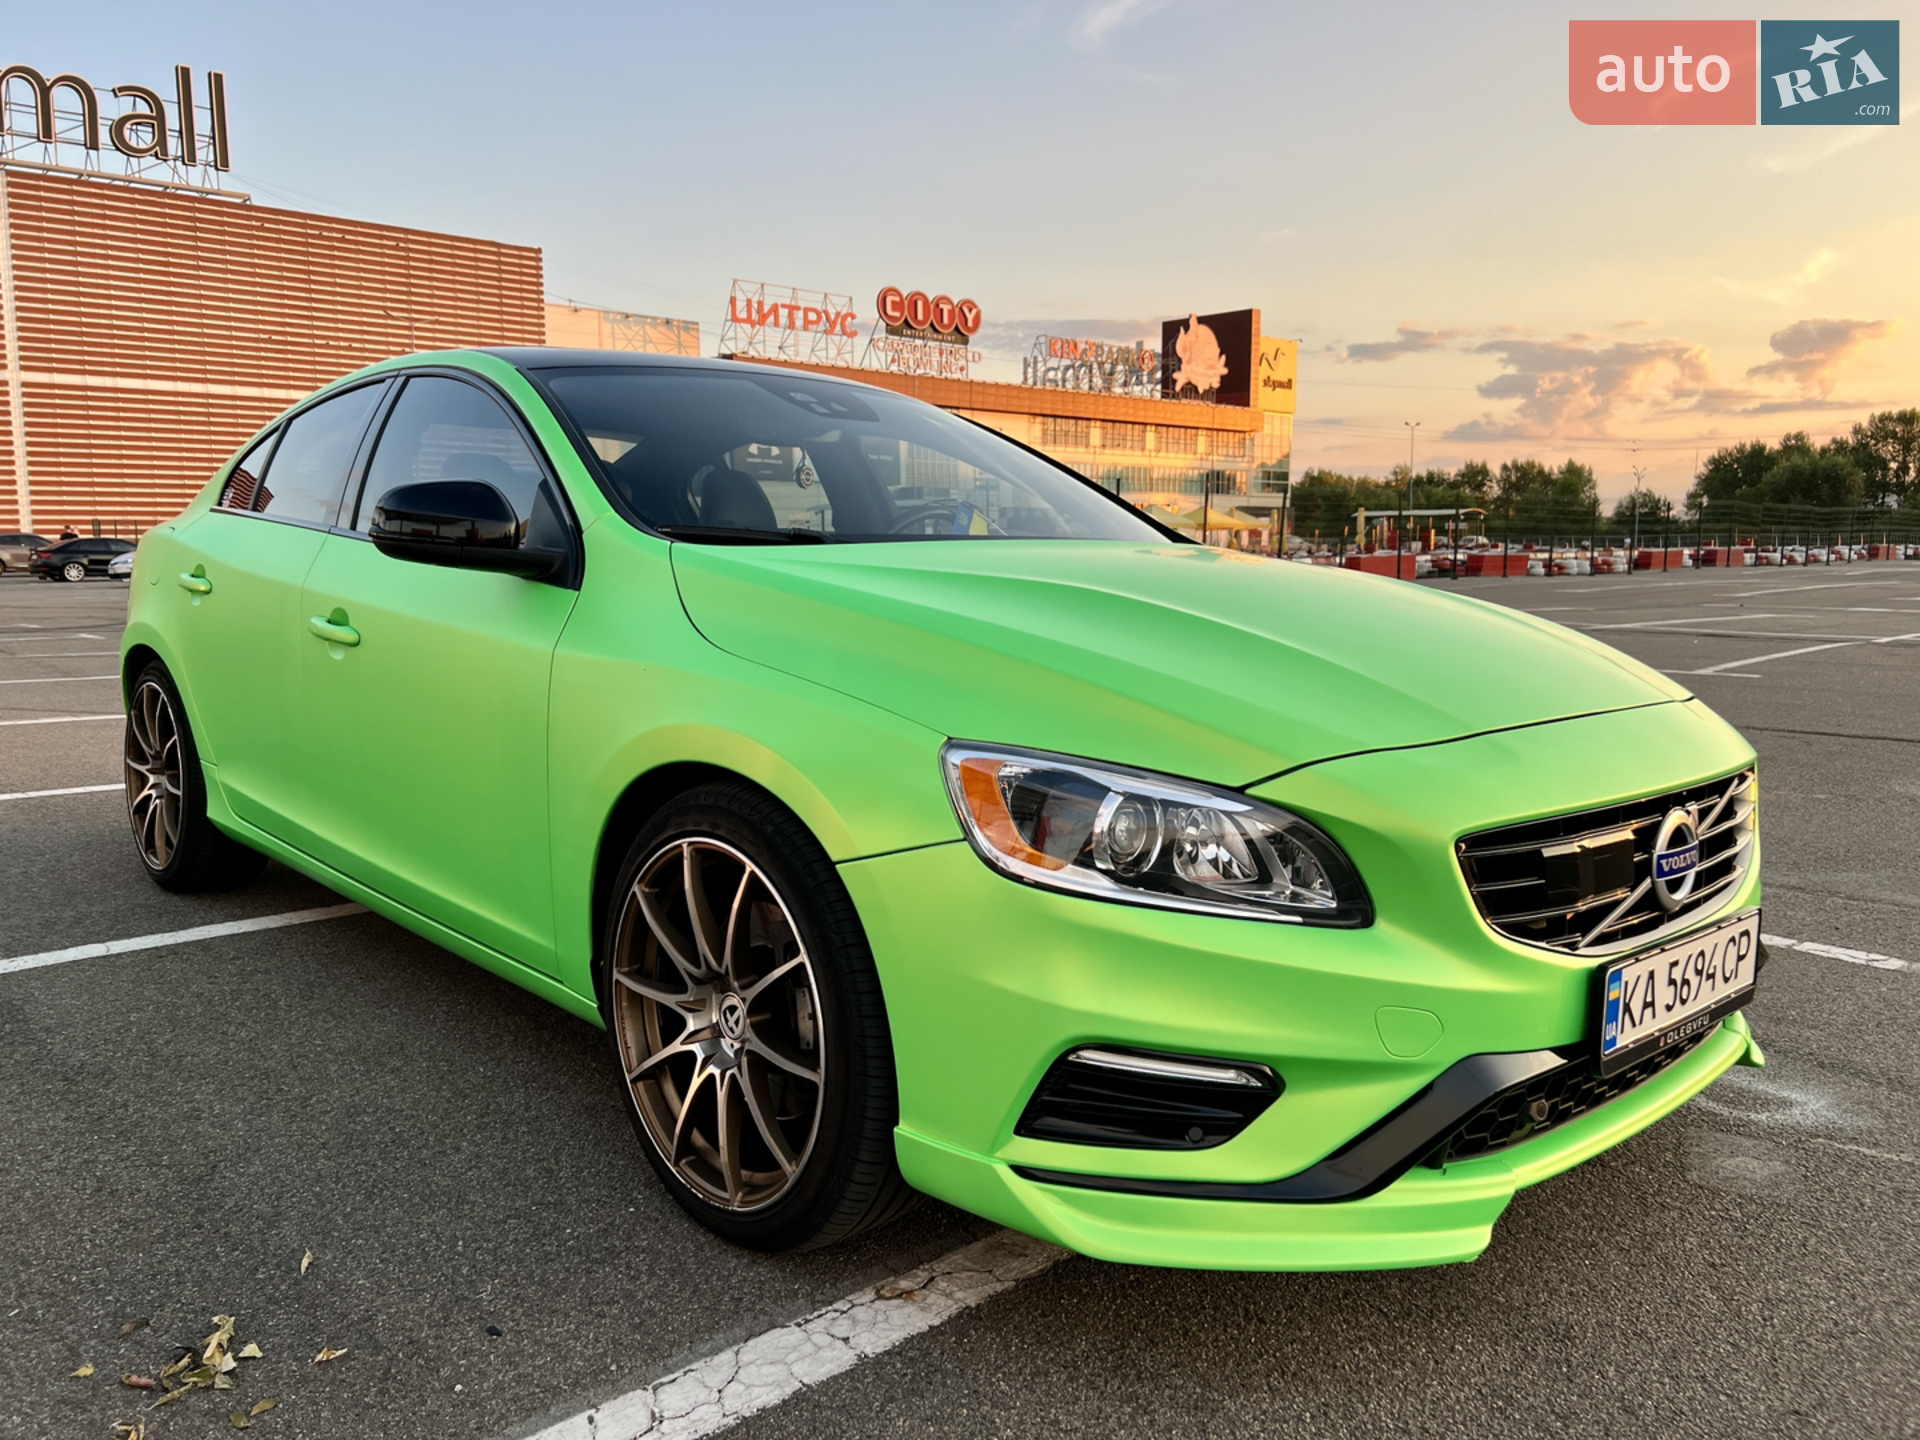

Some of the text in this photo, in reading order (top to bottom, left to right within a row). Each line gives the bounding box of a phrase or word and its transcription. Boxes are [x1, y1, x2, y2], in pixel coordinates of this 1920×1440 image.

[0, 63, 230, 172] mall
[730, 295, 859, 339] ЦИТРУС
[883, 294, 979, 329] CITY
[873, 337, 983, 363] KARAOKE DISCO
[1660, 850, 1698, 872] VOLVO
[1620, 928, 1751, 1034] KA 5694 CP
